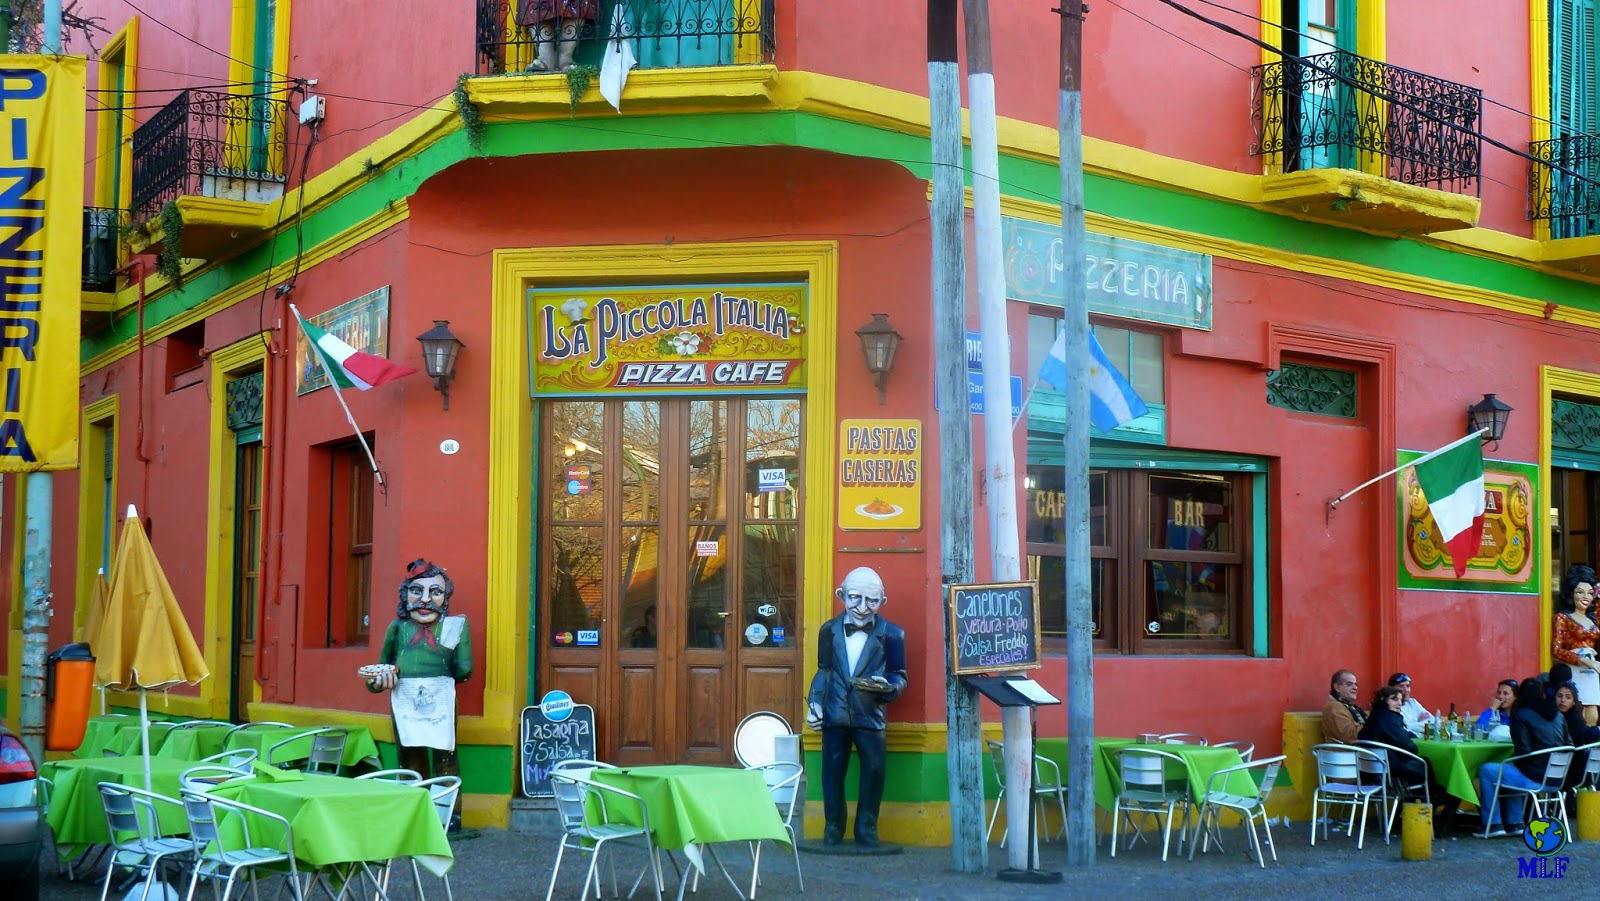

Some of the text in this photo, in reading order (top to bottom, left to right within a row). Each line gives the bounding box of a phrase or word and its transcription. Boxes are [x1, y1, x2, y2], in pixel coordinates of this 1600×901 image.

[0, 68, 47, 463] PIZZERIA
[1049, 237, 1189, 305] PZZERIA
[543, 291, 790, 368] LA PICCOLA ITALIA
[615, 360, 791, 387] PIZZA CAFE
[847, 426, 918, 453] PASTAS
[762, 471, 785, 481] VISA
[842, 458, 918, 486] CASERAS
[1035, 490, 1066, 518] CAF
[1173, 500, 1206, 528] BAR
[955, 589, 1023, 619] Canelones
[580, 632, 598, 640] VISA
